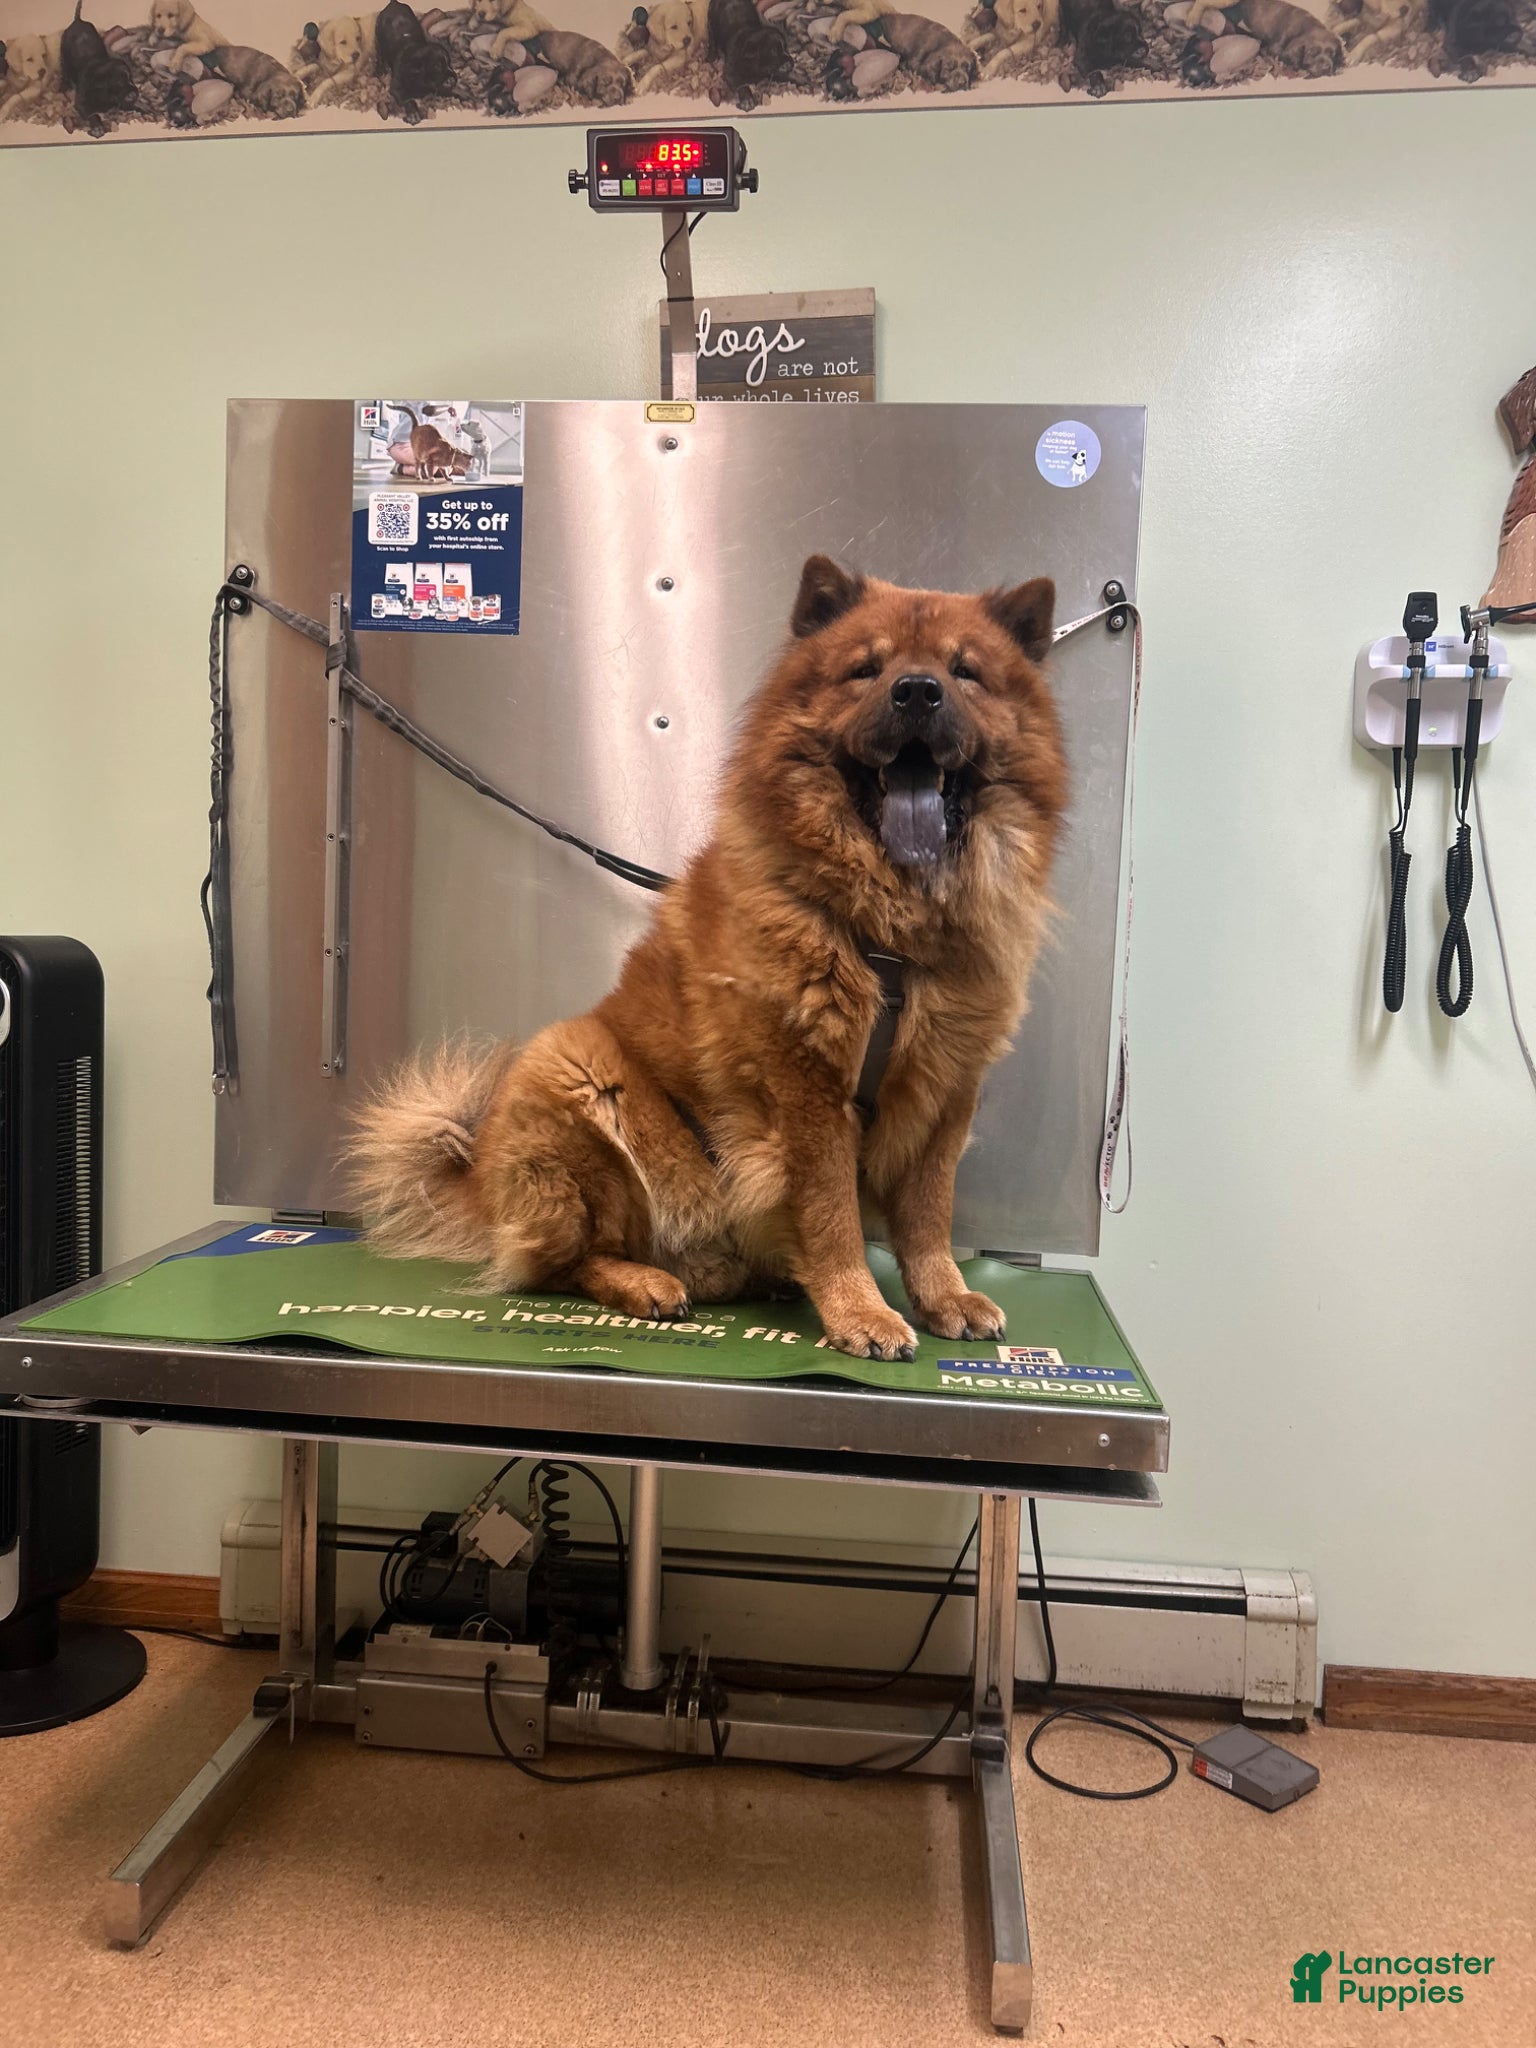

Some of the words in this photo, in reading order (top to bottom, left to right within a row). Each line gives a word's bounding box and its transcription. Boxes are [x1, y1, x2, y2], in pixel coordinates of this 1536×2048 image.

[777, 362, 814, 377] are
[823, 356, 859, 376] not
[803, 387, 860, 403] lives
[441, 500, 462, 511] Get
[464, 502, 479, 513] up
[481, 501, 494, 511] to
[426, 512, 471, 530] 35%
[477, 513, 510, 531] off
[501, 1299, 551, 1311] The
[278, 1302, 488, 1322] happier,
[502, 1308, 727, 1338] healthier,
[742, 1327, 802, 1344] fit
[472, 1324, 611, 1338] STARTS
[623, 1333, 720, 1349] HERE
[954, 1361, 1116, 1376] PRESCRIPTION
[941, 1375, 1144, 1397] Metabolic
